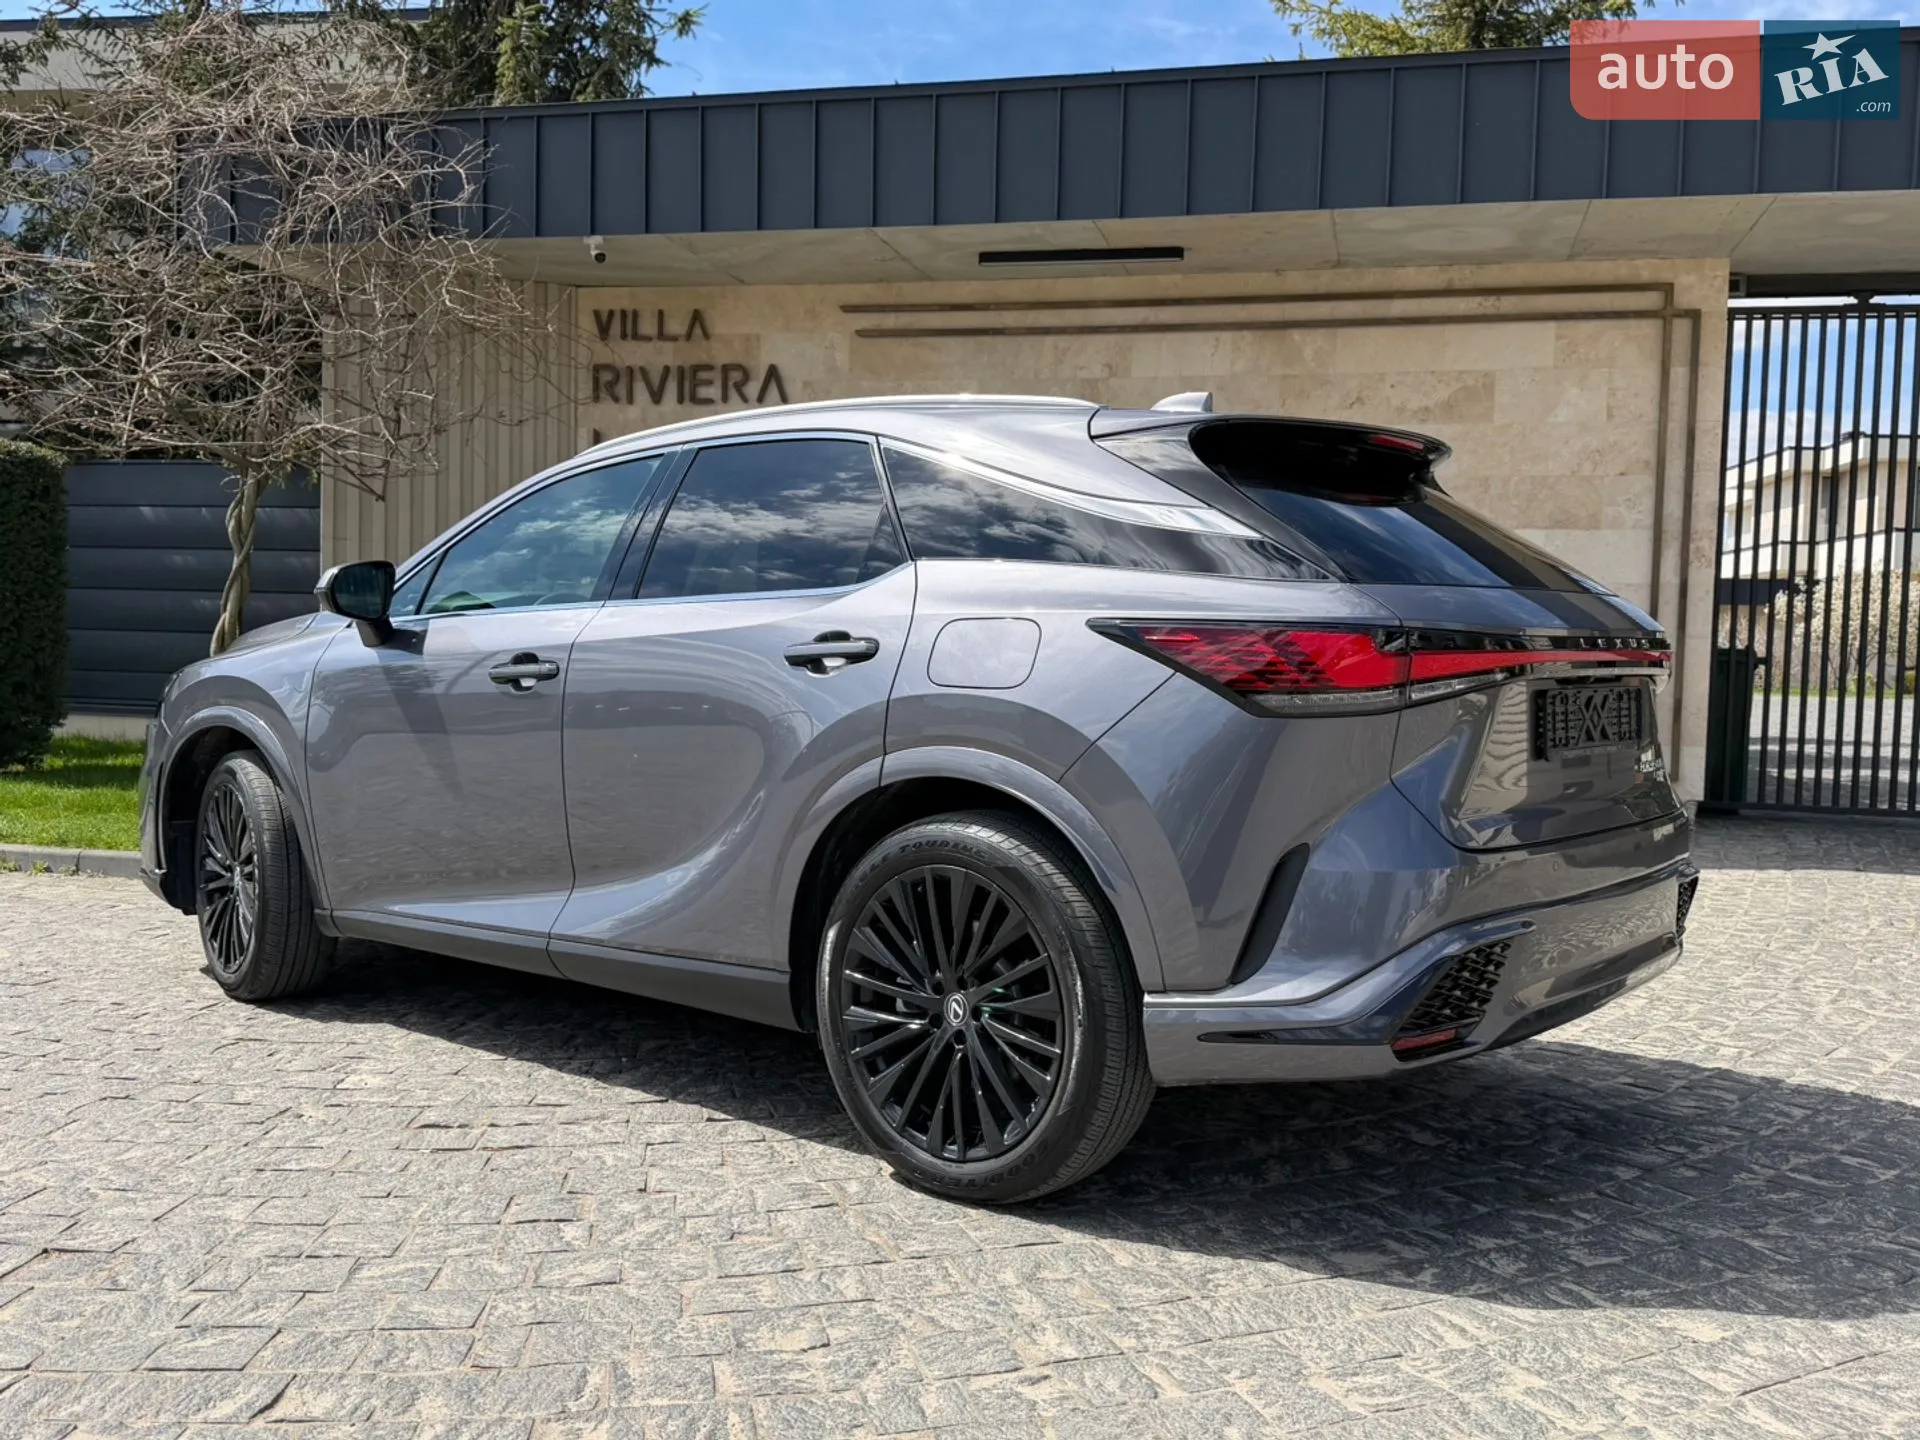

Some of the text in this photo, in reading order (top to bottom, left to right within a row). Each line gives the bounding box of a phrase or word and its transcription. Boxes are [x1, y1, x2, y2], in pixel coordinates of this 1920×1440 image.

[593, 308, 711, 341] VILLA
[592, 363, 788, 405] RIVIERA
[1579, 637, 1650, 649] LEXUS
